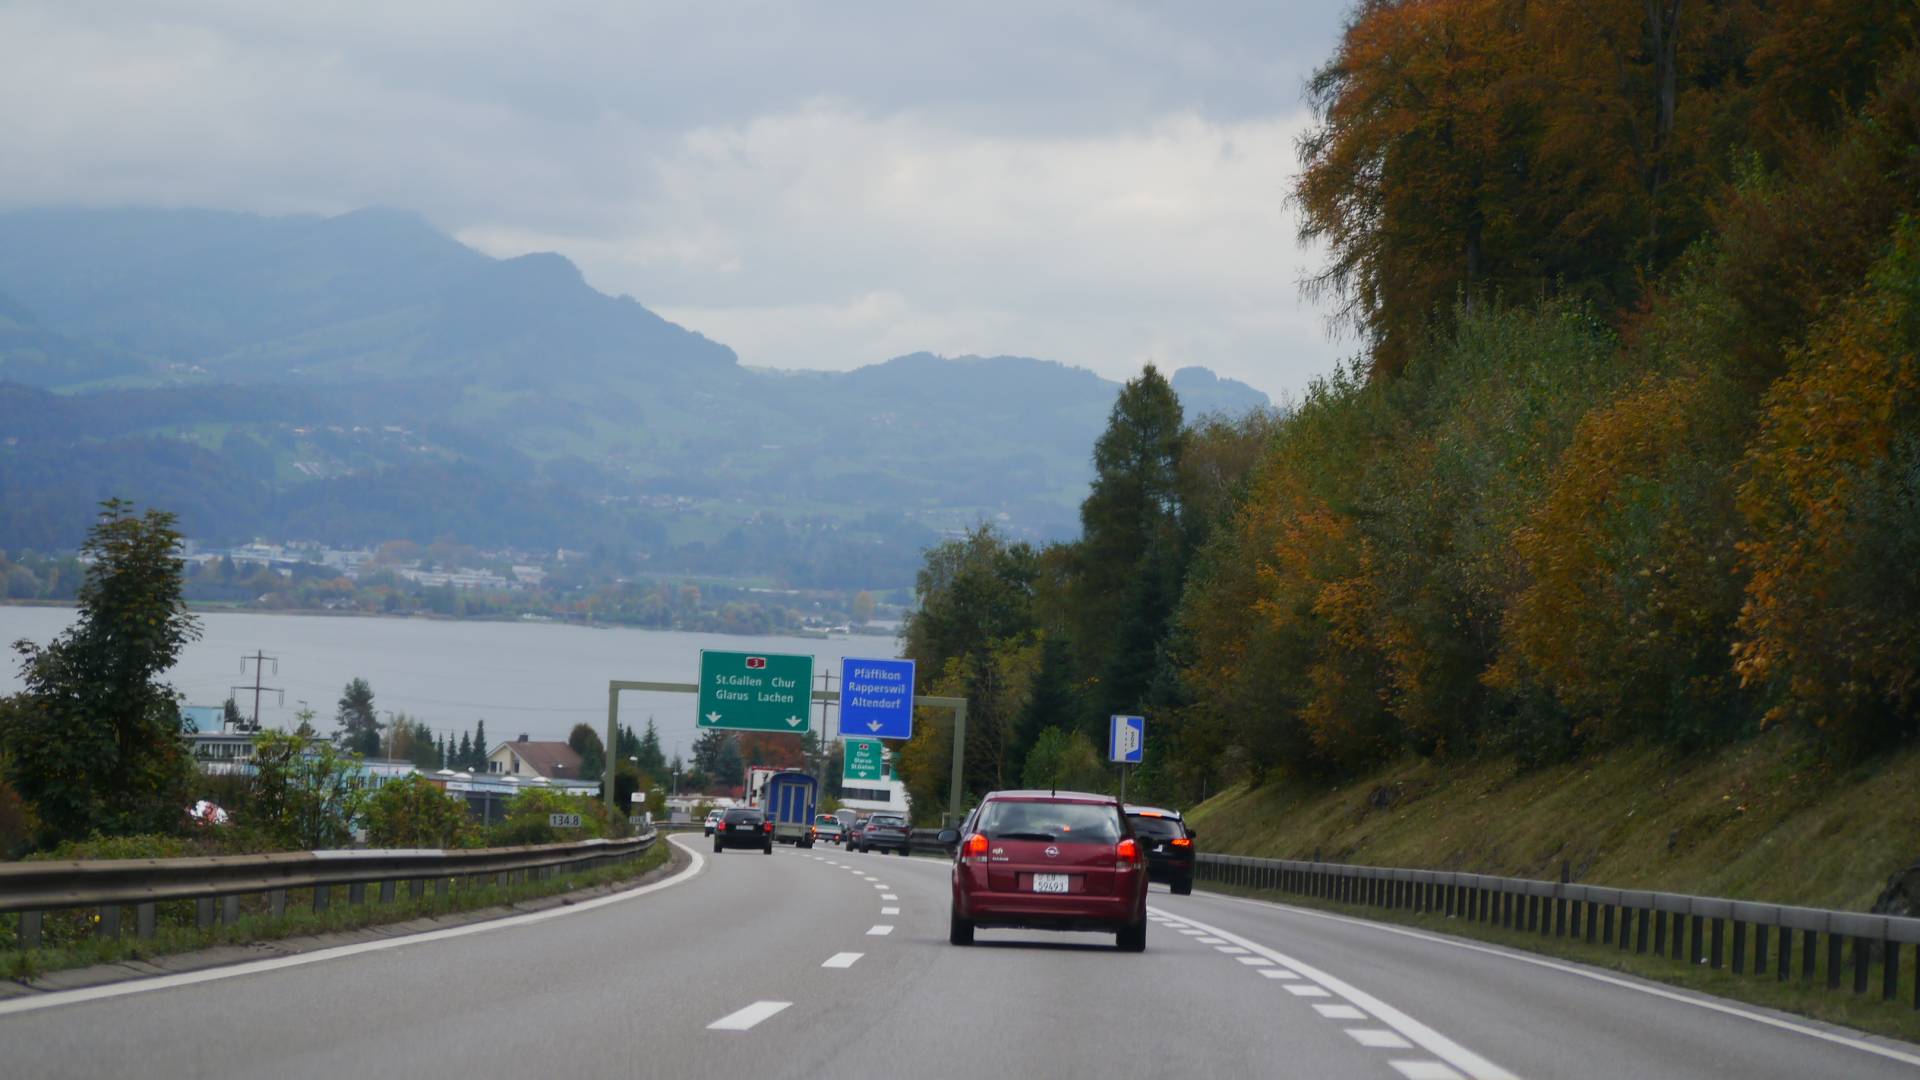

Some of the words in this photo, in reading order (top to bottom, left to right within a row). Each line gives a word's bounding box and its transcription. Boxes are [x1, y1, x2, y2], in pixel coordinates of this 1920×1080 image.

[753, 659, 759, 667] 3
[854, 668, 902, 680] Pfäffikon
[715, 674, 762, 686] St.Gallen
[771, 676, 796, 688] Chur
[848, 681, 905, 694] Rapperswil
[715, 689, 749, 701] Glarus
[758, 691, 794, 703] Lachen
[851, 697, 901, 709] Altendorf
[552, 815, 579, 826] 134.8
